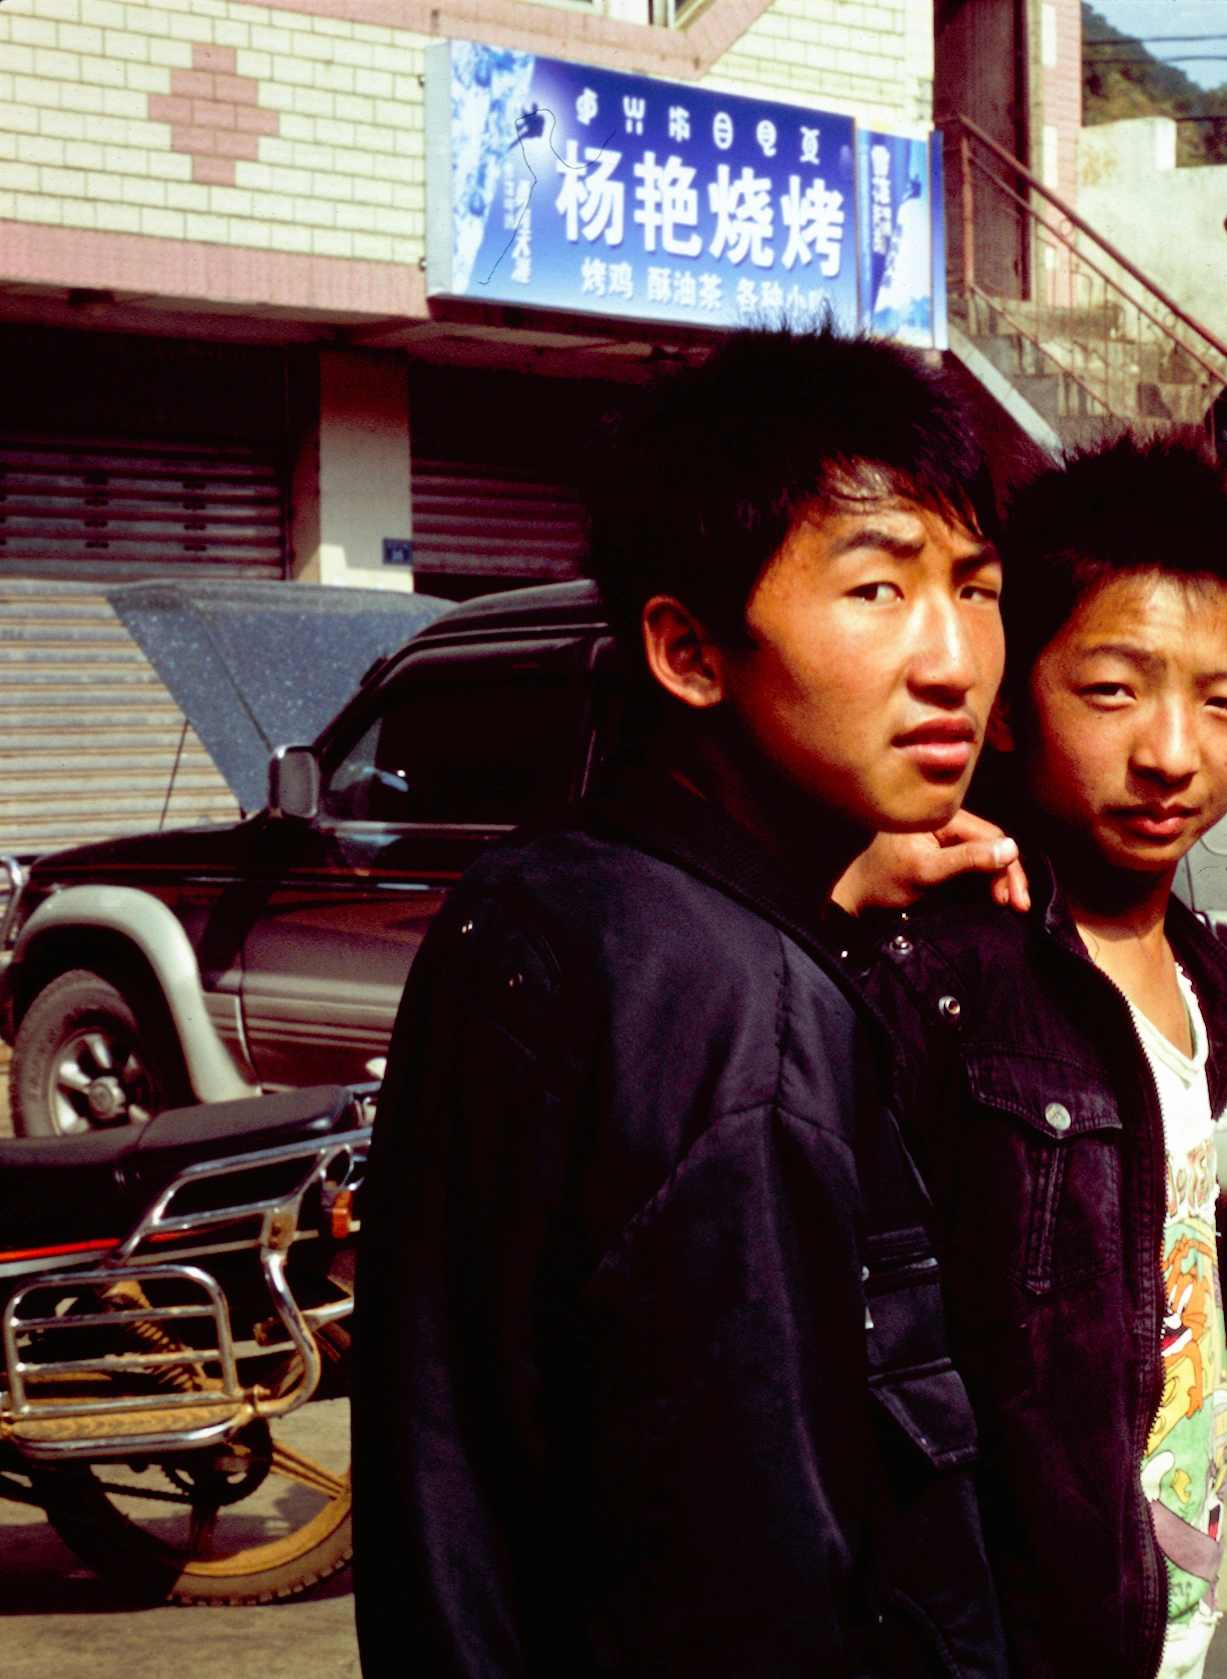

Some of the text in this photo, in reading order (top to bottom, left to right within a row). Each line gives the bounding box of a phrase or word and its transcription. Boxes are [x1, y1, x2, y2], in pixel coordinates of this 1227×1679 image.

[555, 139, 845, 278] 杨艳烧烤
[581, 256, 633, 299] 烤鸡
[647, 266, 723, 310] 酥油茶
